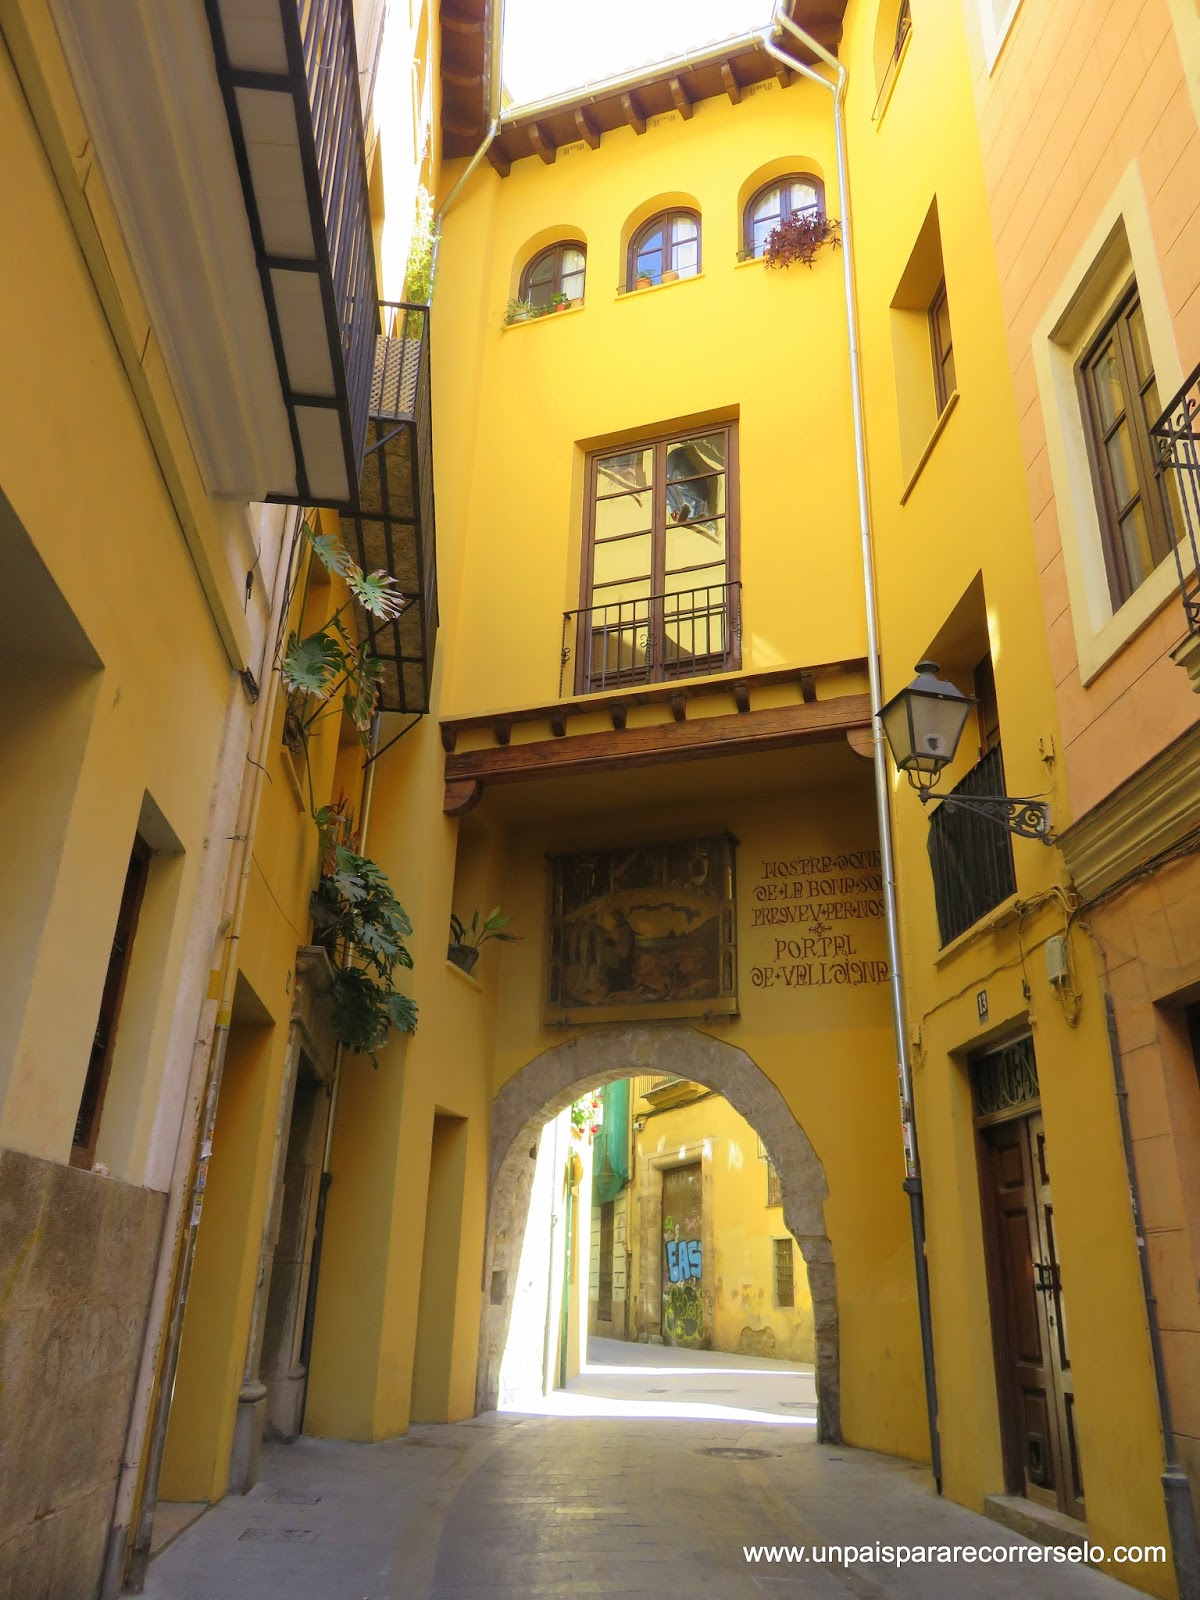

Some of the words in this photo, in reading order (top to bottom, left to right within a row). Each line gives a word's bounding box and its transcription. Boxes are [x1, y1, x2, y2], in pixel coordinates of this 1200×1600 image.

[761, 855, 832, 879] NOSTRA
[753, 883, 777, 901] DE
[781, 881, 804, 901] LA
[806, 877, 855, 899] BONA
[825, 901, 855, 921] PER
[774, 934, 857, 962] PORTAL
[750, 965, 774, 989] DE
[977, 992, 987, 1014] 13
